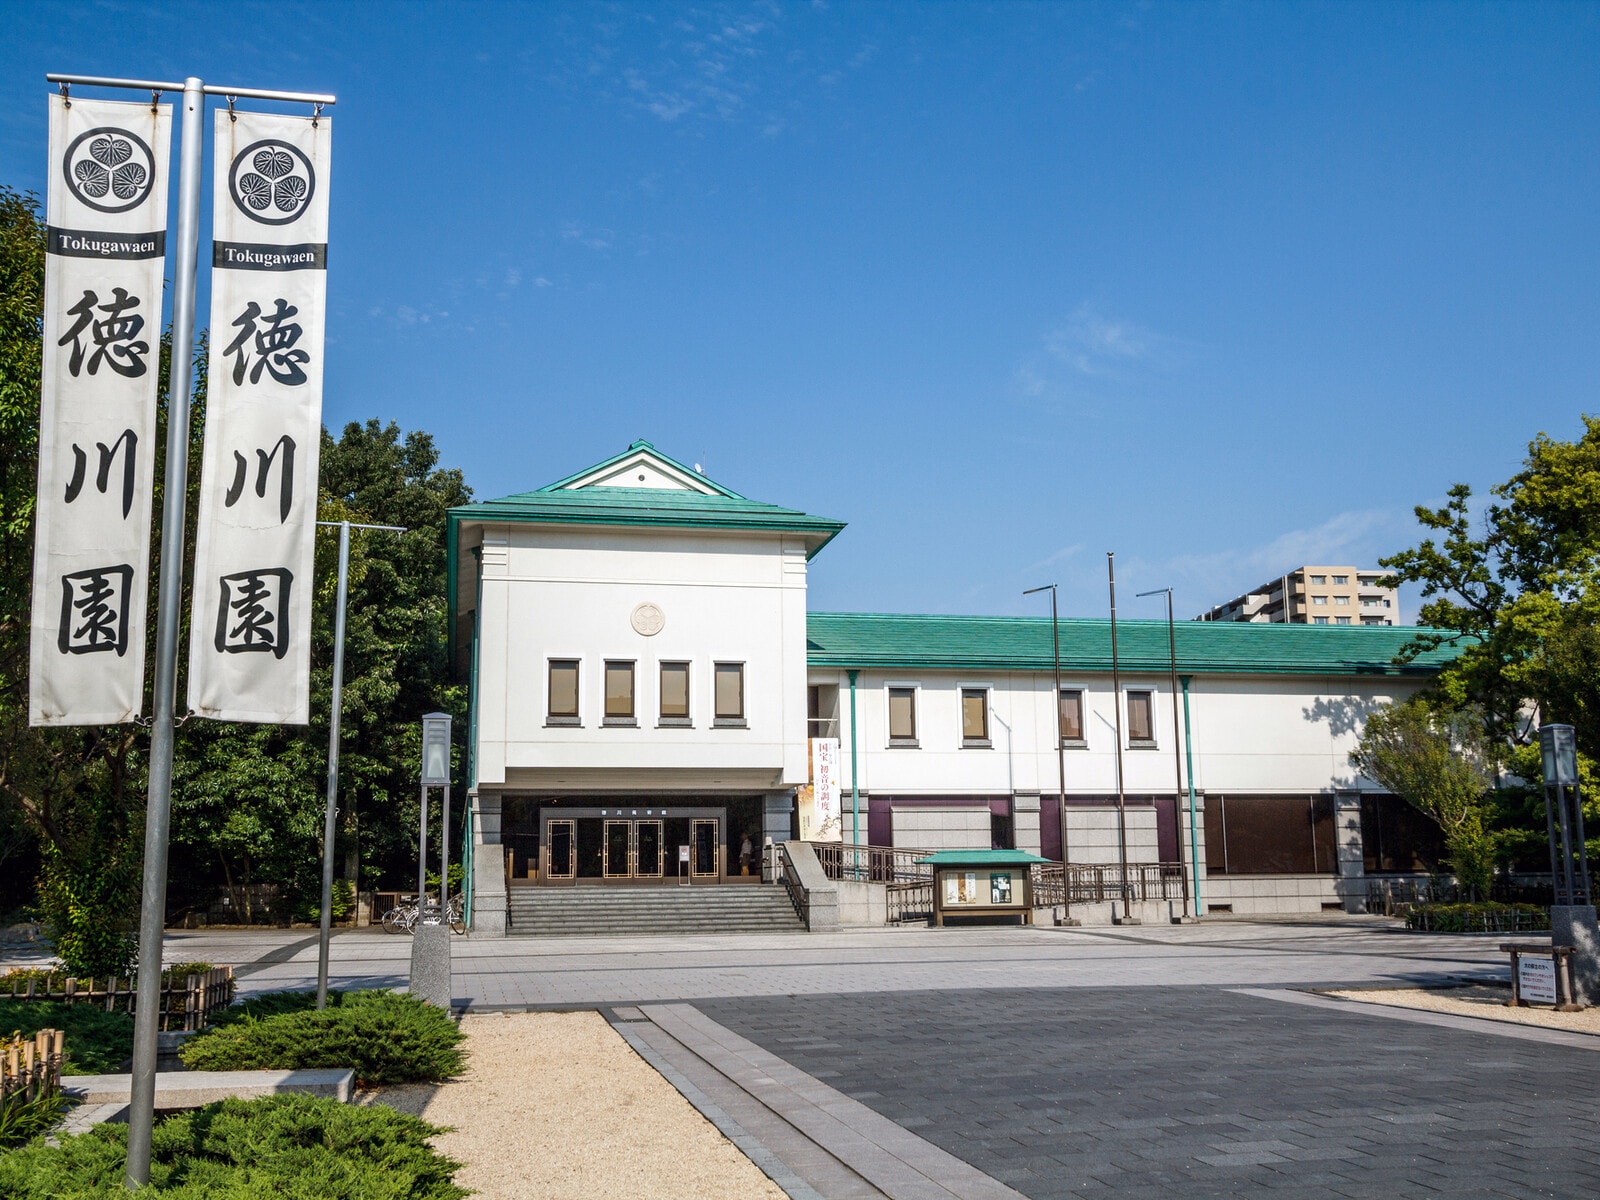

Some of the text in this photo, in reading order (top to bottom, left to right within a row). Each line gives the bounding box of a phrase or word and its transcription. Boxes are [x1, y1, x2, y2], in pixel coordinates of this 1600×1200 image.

[59, 234, 155, 255] Tokugawaen
[225, 247, 315, 267] Tokugawaen
[57, 285, 150, 657] 徳川園
[213, 297, 310, 660] 徳川園
